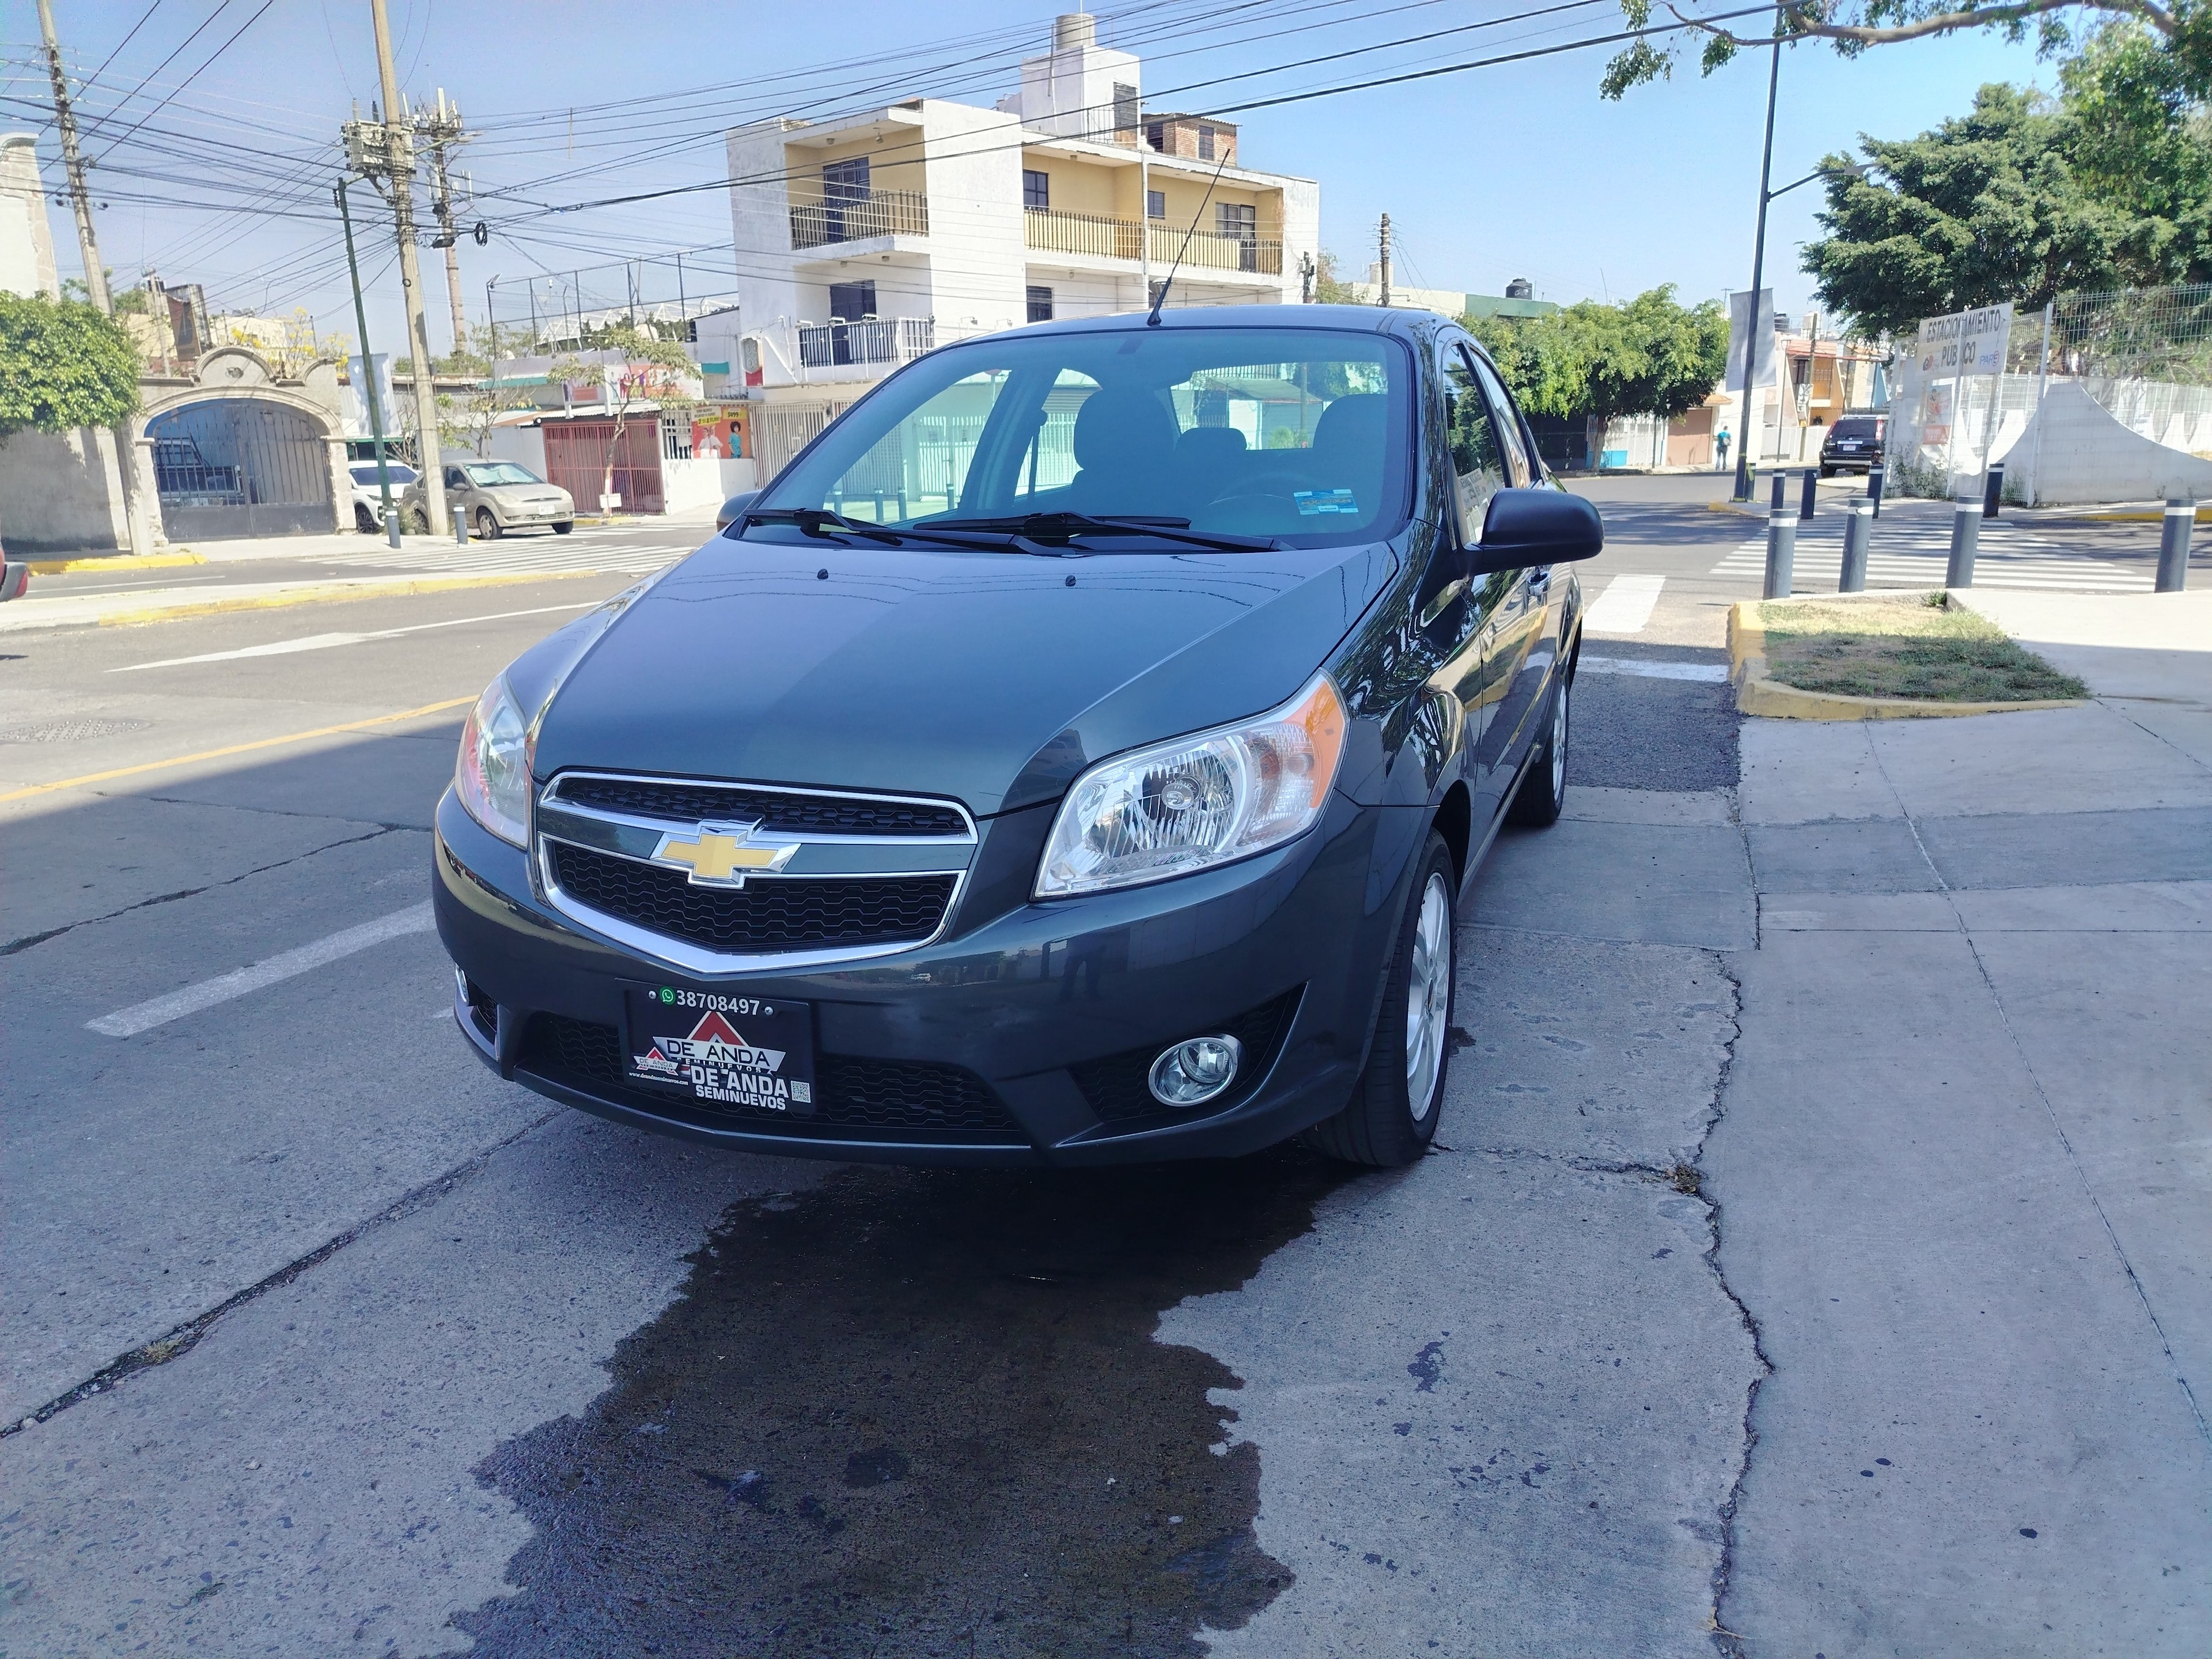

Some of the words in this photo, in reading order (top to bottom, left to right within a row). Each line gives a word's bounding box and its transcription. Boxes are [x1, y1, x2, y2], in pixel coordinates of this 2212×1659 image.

[1941, 340, 1976, 367] PÚBCO
[677, 990, 760, 1015] 38708497
[667, 1040, 695, 1056] DE
[706, 1043, 770, 1066] ANDA
[691, 1066, 719, 1087] DE
[726, 1071, 789, 1098] ANDA
[695, 1085, 786, 1110] SEMINUEVOS
